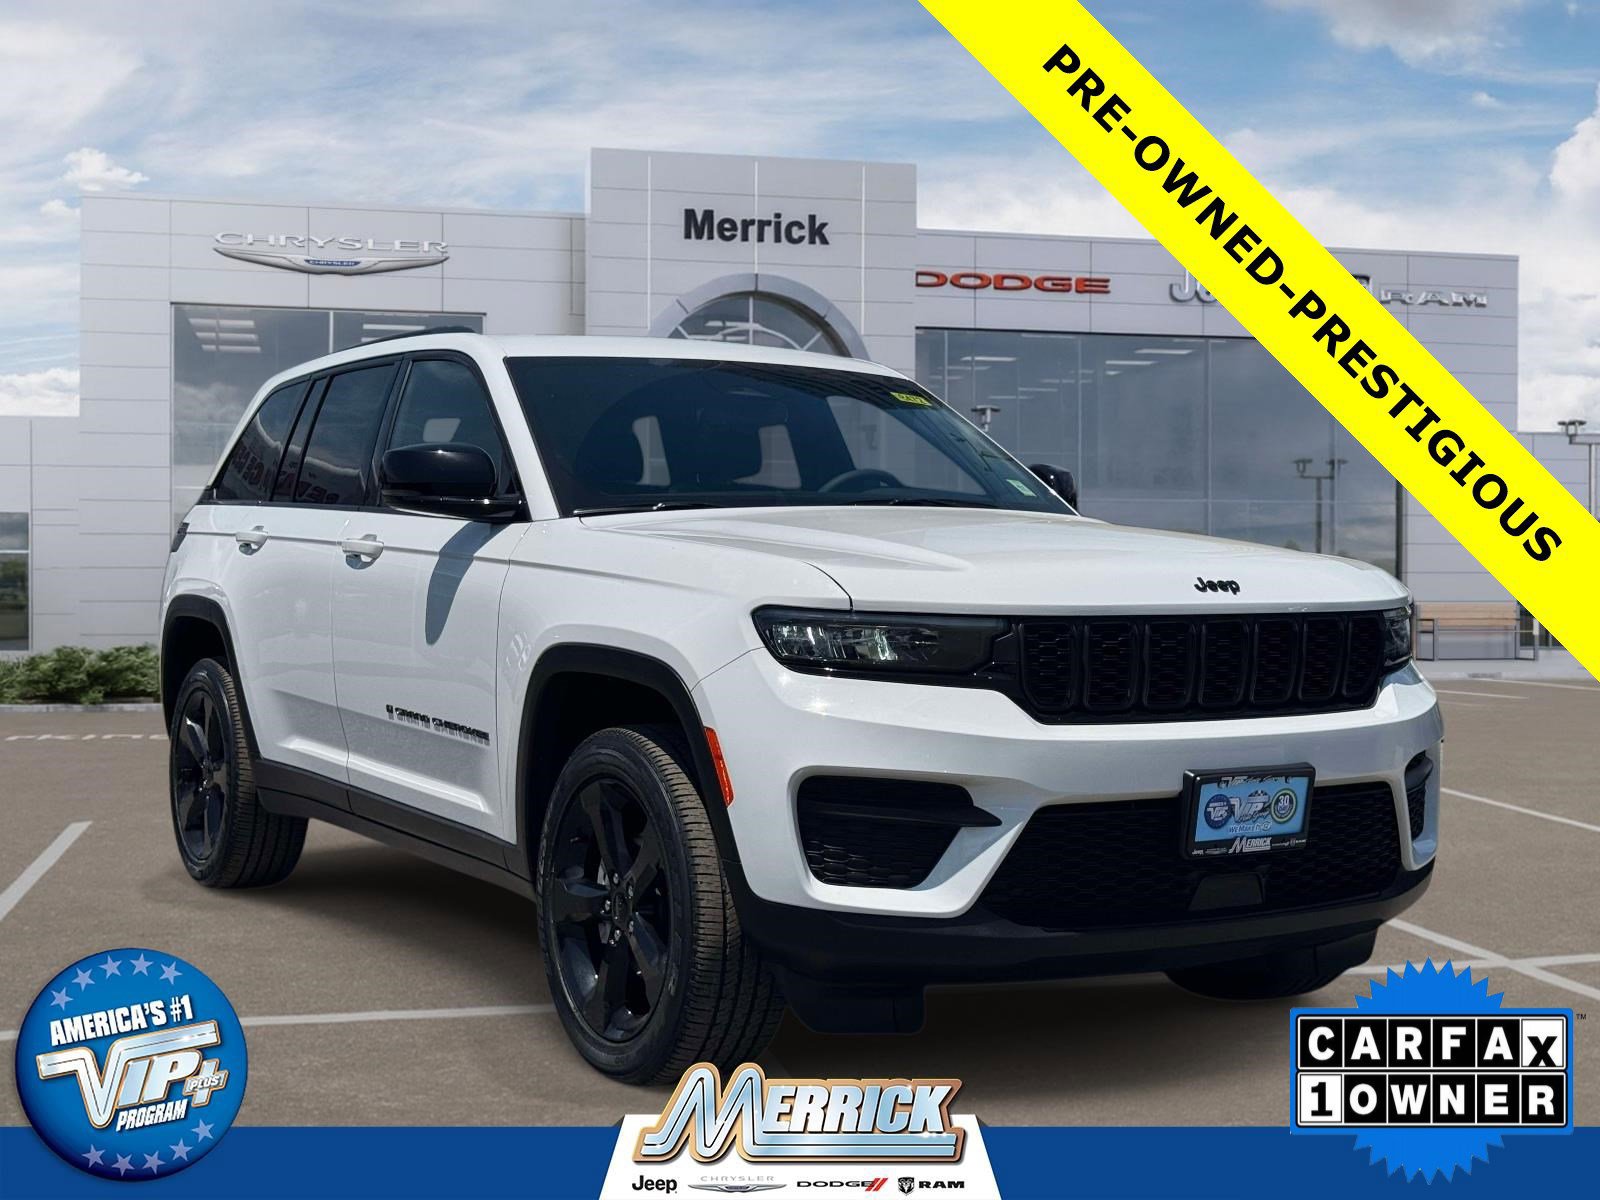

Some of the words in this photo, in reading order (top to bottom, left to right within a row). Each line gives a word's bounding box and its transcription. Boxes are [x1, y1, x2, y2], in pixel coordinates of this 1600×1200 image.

[683, 207, 830, 246] Merrick
[214, 231, 450, 254] CHRYSLER
[915, 271, 1111, 294] DODGE
[1380, 290, 1488, 308] RAM
[1193, 576, 1241, 596] Jeep
[1279, 794, 1290, 806] 30
